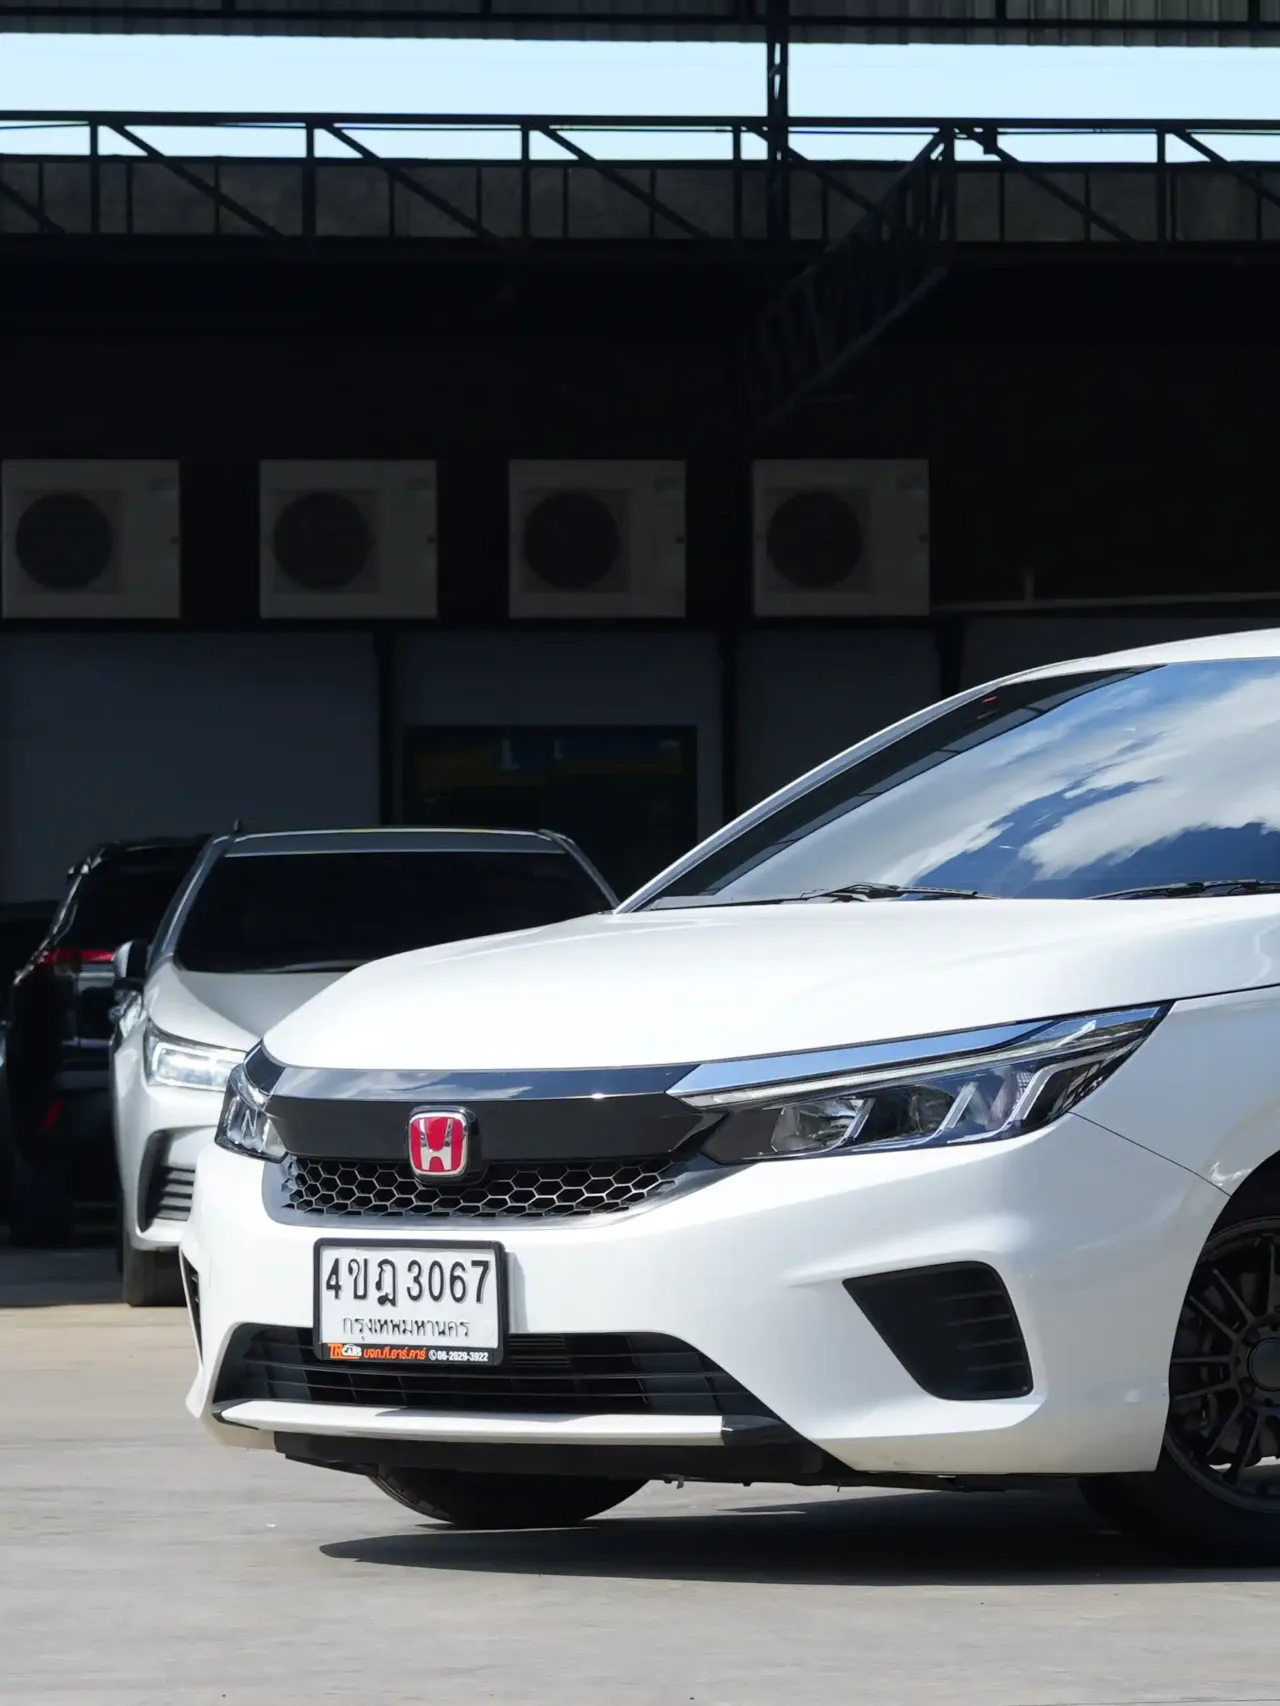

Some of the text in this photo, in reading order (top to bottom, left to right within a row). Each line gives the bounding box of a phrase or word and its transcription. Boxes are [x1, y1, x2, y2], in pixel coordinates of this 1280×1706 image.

[326, 1258, 490, 1306] 4ขฎ 3067
[343, 1317, 470, 1342] กรุงเทพมหานคร
